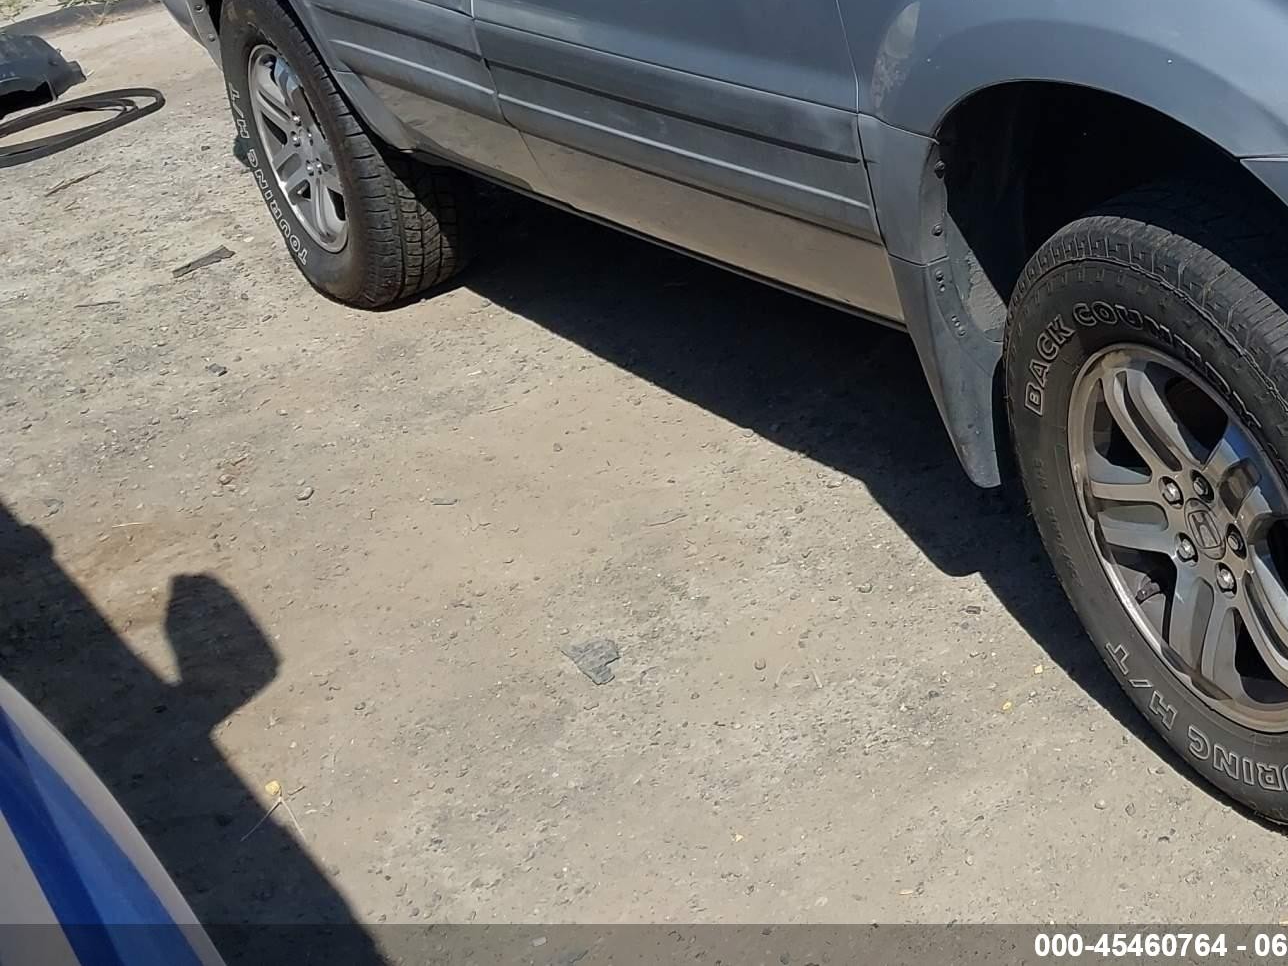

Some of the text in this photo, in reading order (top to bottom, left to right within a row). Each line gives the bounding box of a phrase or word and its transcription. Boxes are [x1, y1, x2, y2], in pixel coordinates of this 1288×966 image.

[228, 82, 309, 266] TOURING H/T
[1024, 313, 1076, 417] BACK
[1104, 642, 1178, 731] H/T
